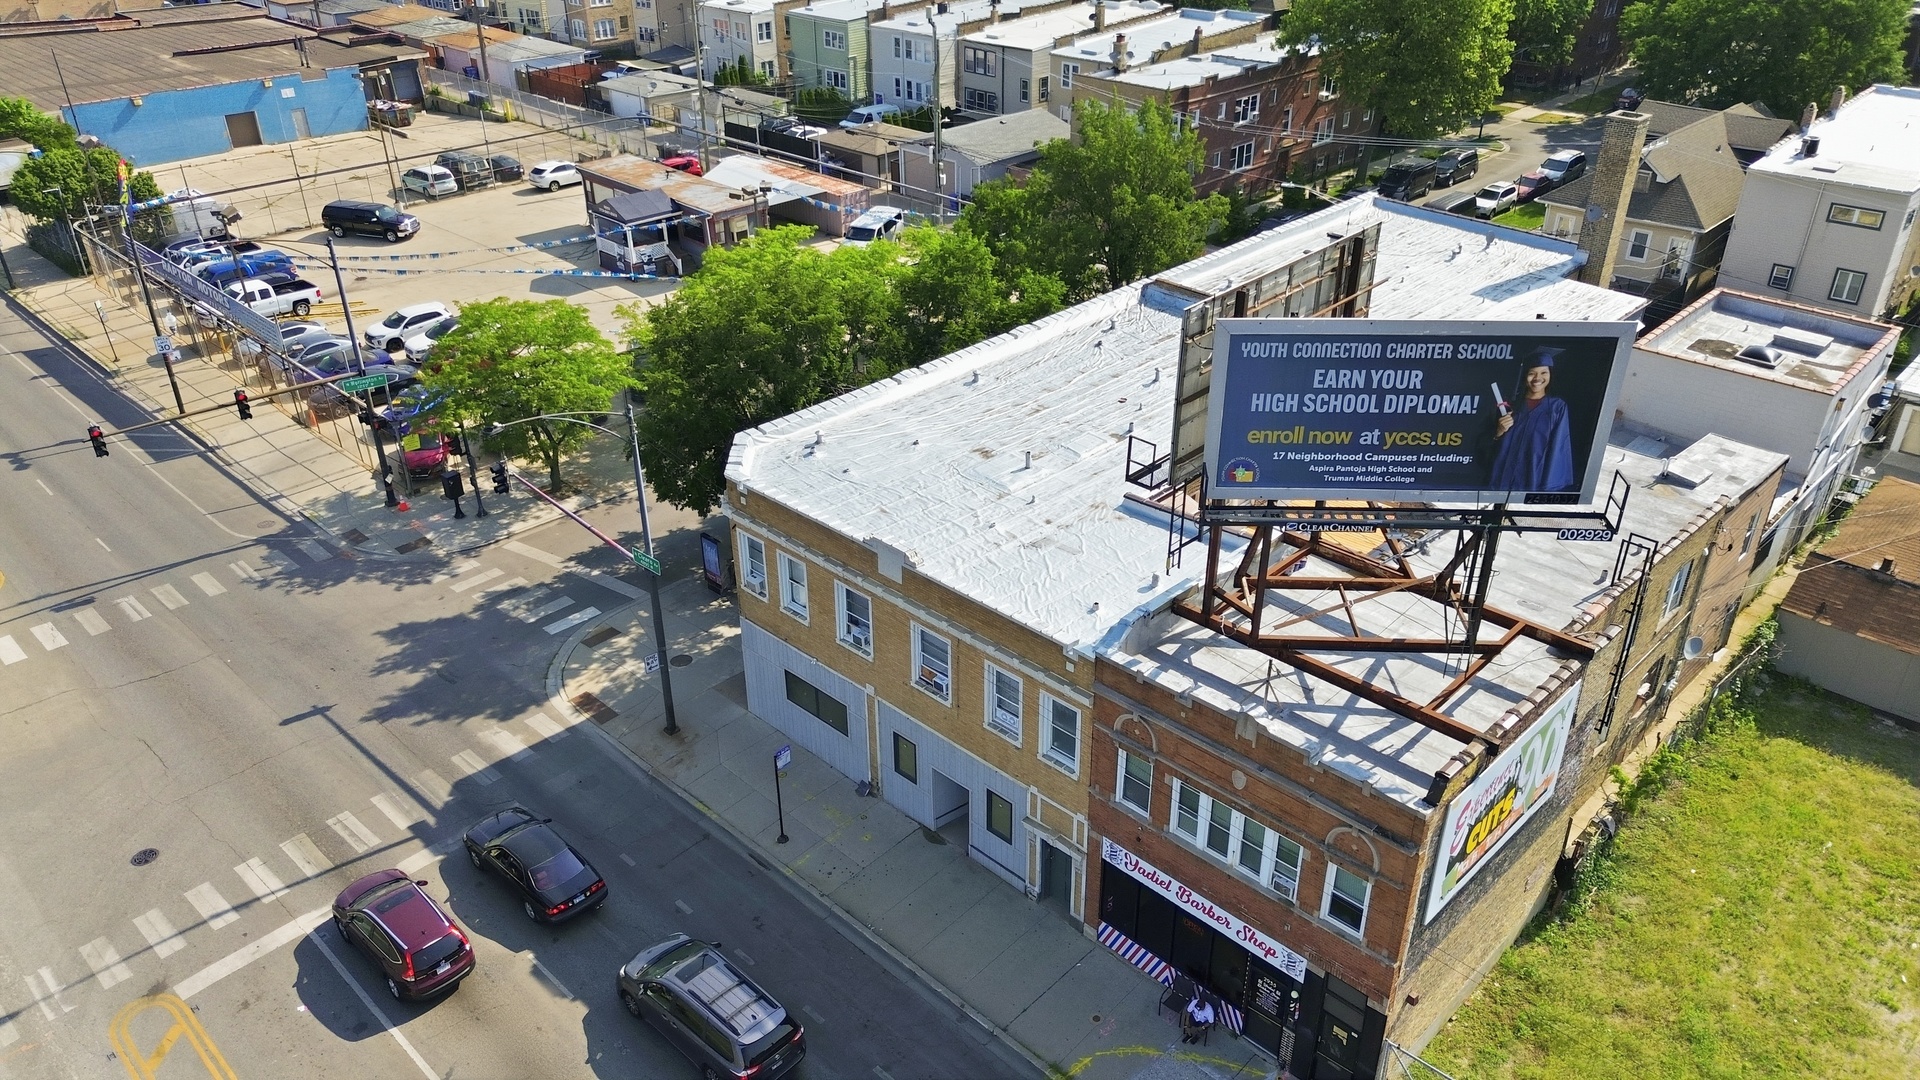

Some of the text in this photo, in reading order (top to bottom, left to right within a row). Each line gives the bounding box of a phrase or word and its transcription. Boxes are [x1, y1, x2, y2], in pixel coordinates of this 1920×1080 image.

[162, 260, 194, 286] RAPTOR
[197, 280, 231, 309] MOTORS
[158, 344, 170, 352] 30
[1241, 342, 1514, 360] YOUTH CONNECTION CHARTER SCHOOL
[1312, 369, 1424, 390] EARN YOUR
[1250, 393, 1480, 415] HIGH SCHOOL DIPLOMA!
[1247, 425, 1463, 450] enroll now at yccs.us
[1273, 451, 1473, 465] 17 Neighborhood Campuses Including:
[1308, 464, 1334, 473] Aspira
[1335, 465, 1366, 474] Pantoja
[1367, 466, 1387, 474] High
[1384, 475, 1416, 484] College
[1558, 528, 1612, 541] 002929
[1466, 787, 1517, 855] CUTS
[1123, 852, 1172, 893] Yadiel
[1175, 885, 1233, 930] Barber
[1236, 924, 1279, 960] Shop
